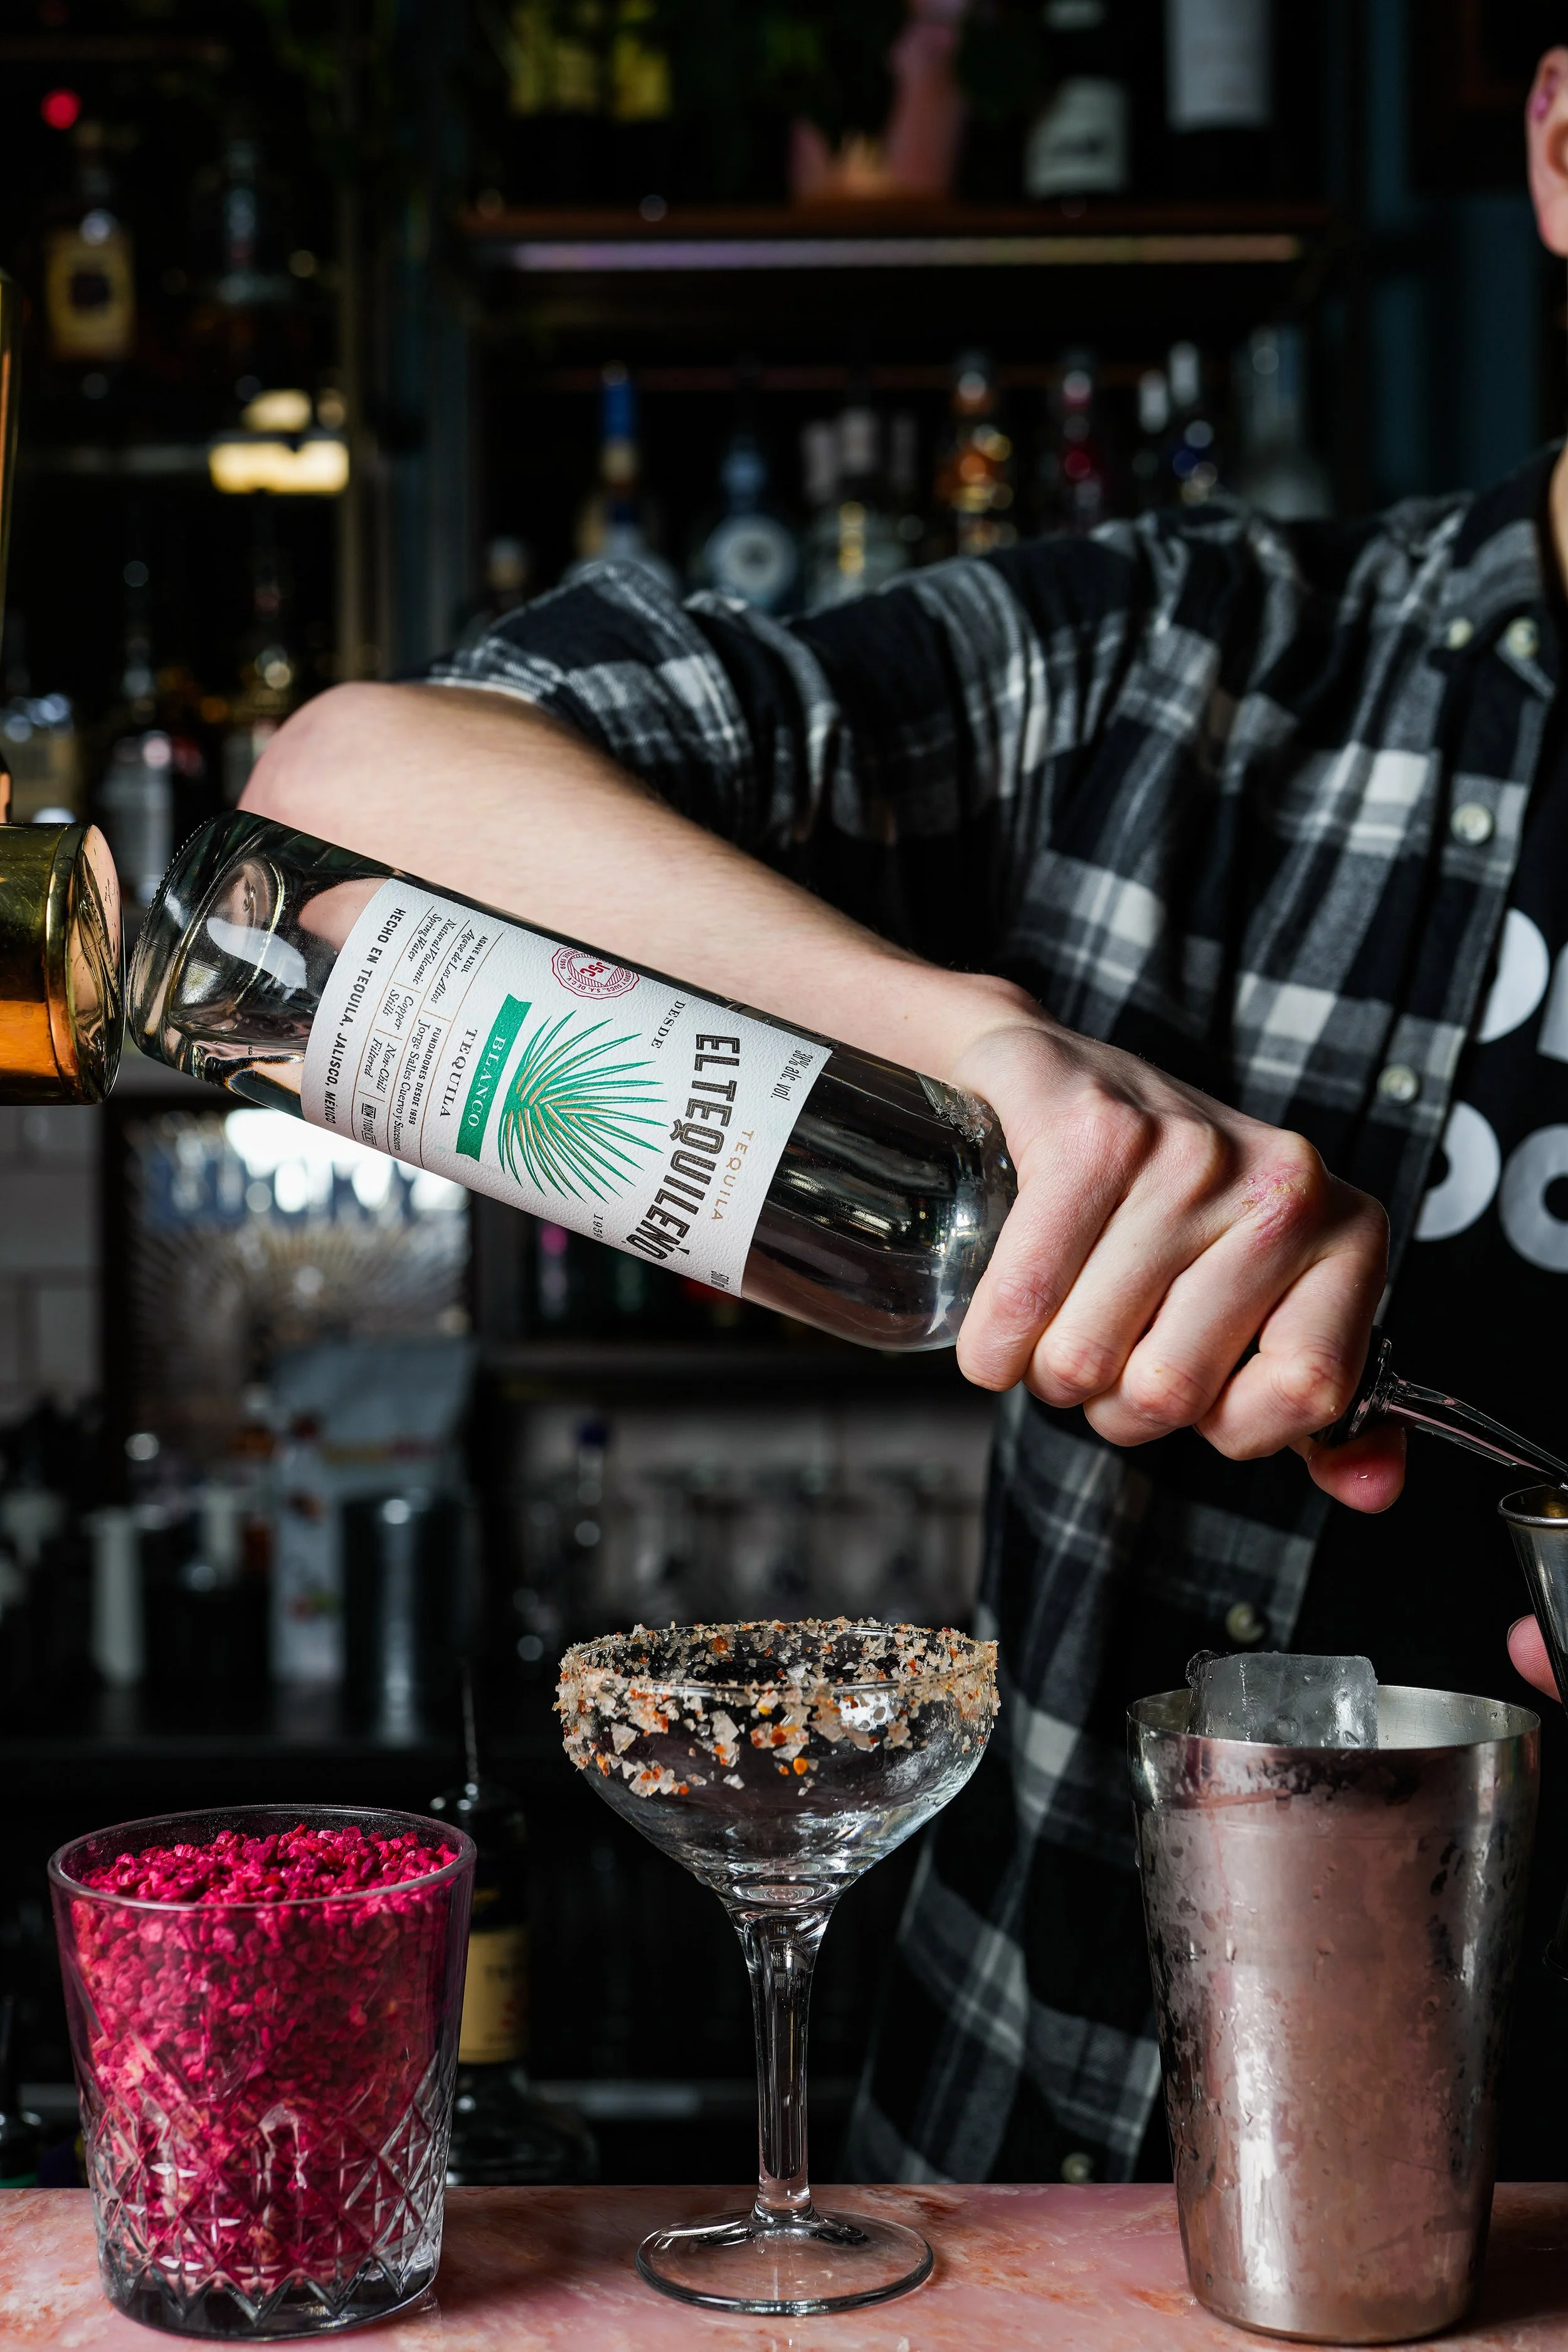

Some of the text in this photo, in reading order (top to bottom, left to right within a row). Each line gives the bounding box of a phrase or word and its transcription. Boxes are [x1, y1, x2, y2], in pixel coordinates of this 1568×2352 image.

[408, 913, 442, 961] Spring Water
[413, 919, 457, 985] Natural Volcanic
[461, 935, 489, 973] AGAVE AZUL
[431, 929, 475, 1004] Agave de Los Altos
[580, 961, 610, 977] JSC
[324, 908, 406, 1124] HECHO EN TEQUILA, JALISCO, MÉXICO
[383, 989, 400, 1016] Stills
[395, 995, 414, 1030] Copper
[651, 1000, 686, 1049] DESDE
[364, 1037, 383, 1079] Filtered
[376, 1042, 397, 1094] Non-Chill
[408, 1027, 442, 1125] FUNDADORES DESDE 1959
[440, 1028, 478, 1117] TEQUILA
[694, 1034, 740, 1072] EL
[771, 1050, 813, 1101] 38% alc. vol.
[393, 1019, 431, 1152] Jorge Salles Cuervo y Sucesores
[468, 1034, 507, 1127] BLANCO
[363, 1103, 374, 1118] NOM
[363, 1118, 373, 1133] 1108
[711, 1130, 755, 1221] TEQUILA
[593, 1213, 603, 1239] 1959
